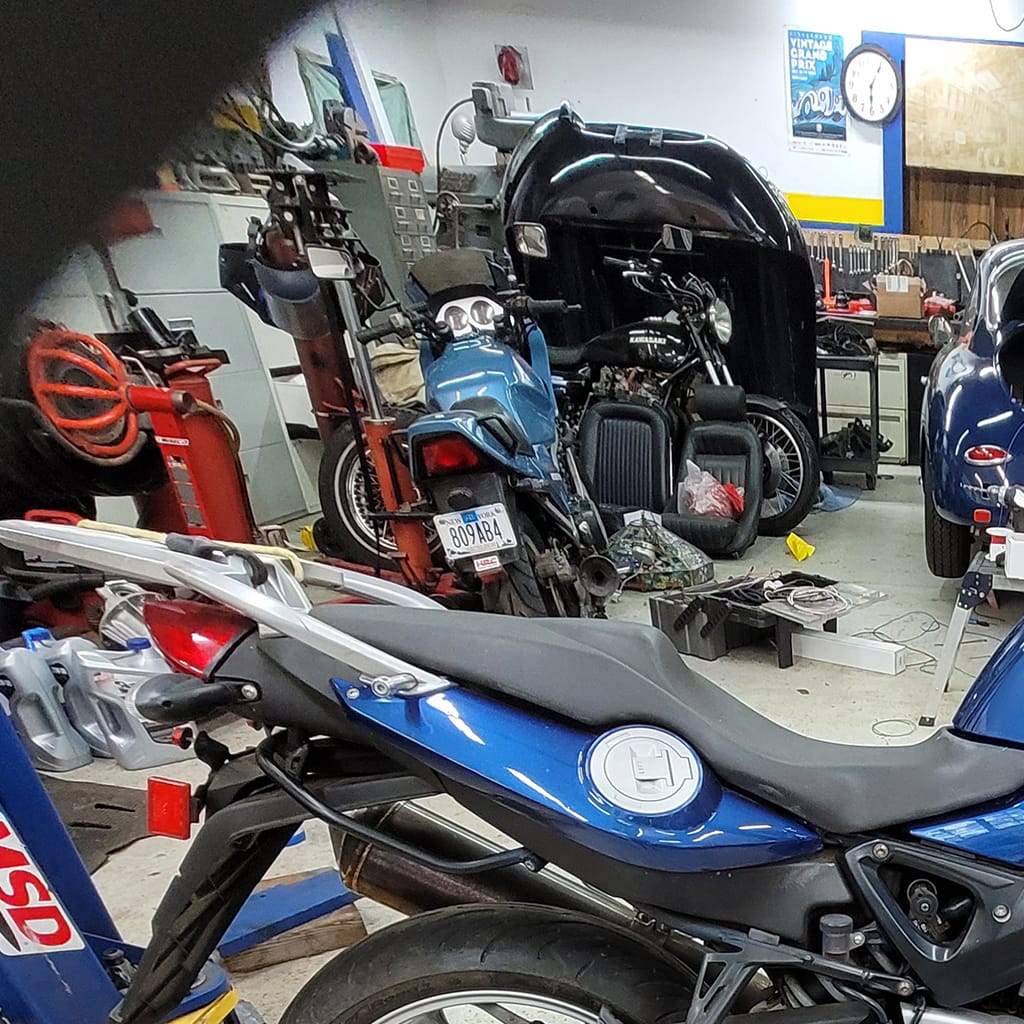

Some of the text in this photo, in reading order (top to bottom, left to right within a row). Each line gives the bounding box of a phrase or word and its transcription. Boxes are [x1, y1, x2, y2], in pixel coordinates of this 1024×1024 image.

[791, 48, 828, 61] GRAND
[791, 60, 816, 72] PRIX
[477, 511, 497, 520] YORK
[449, 518, 503, 548] 809AB4
